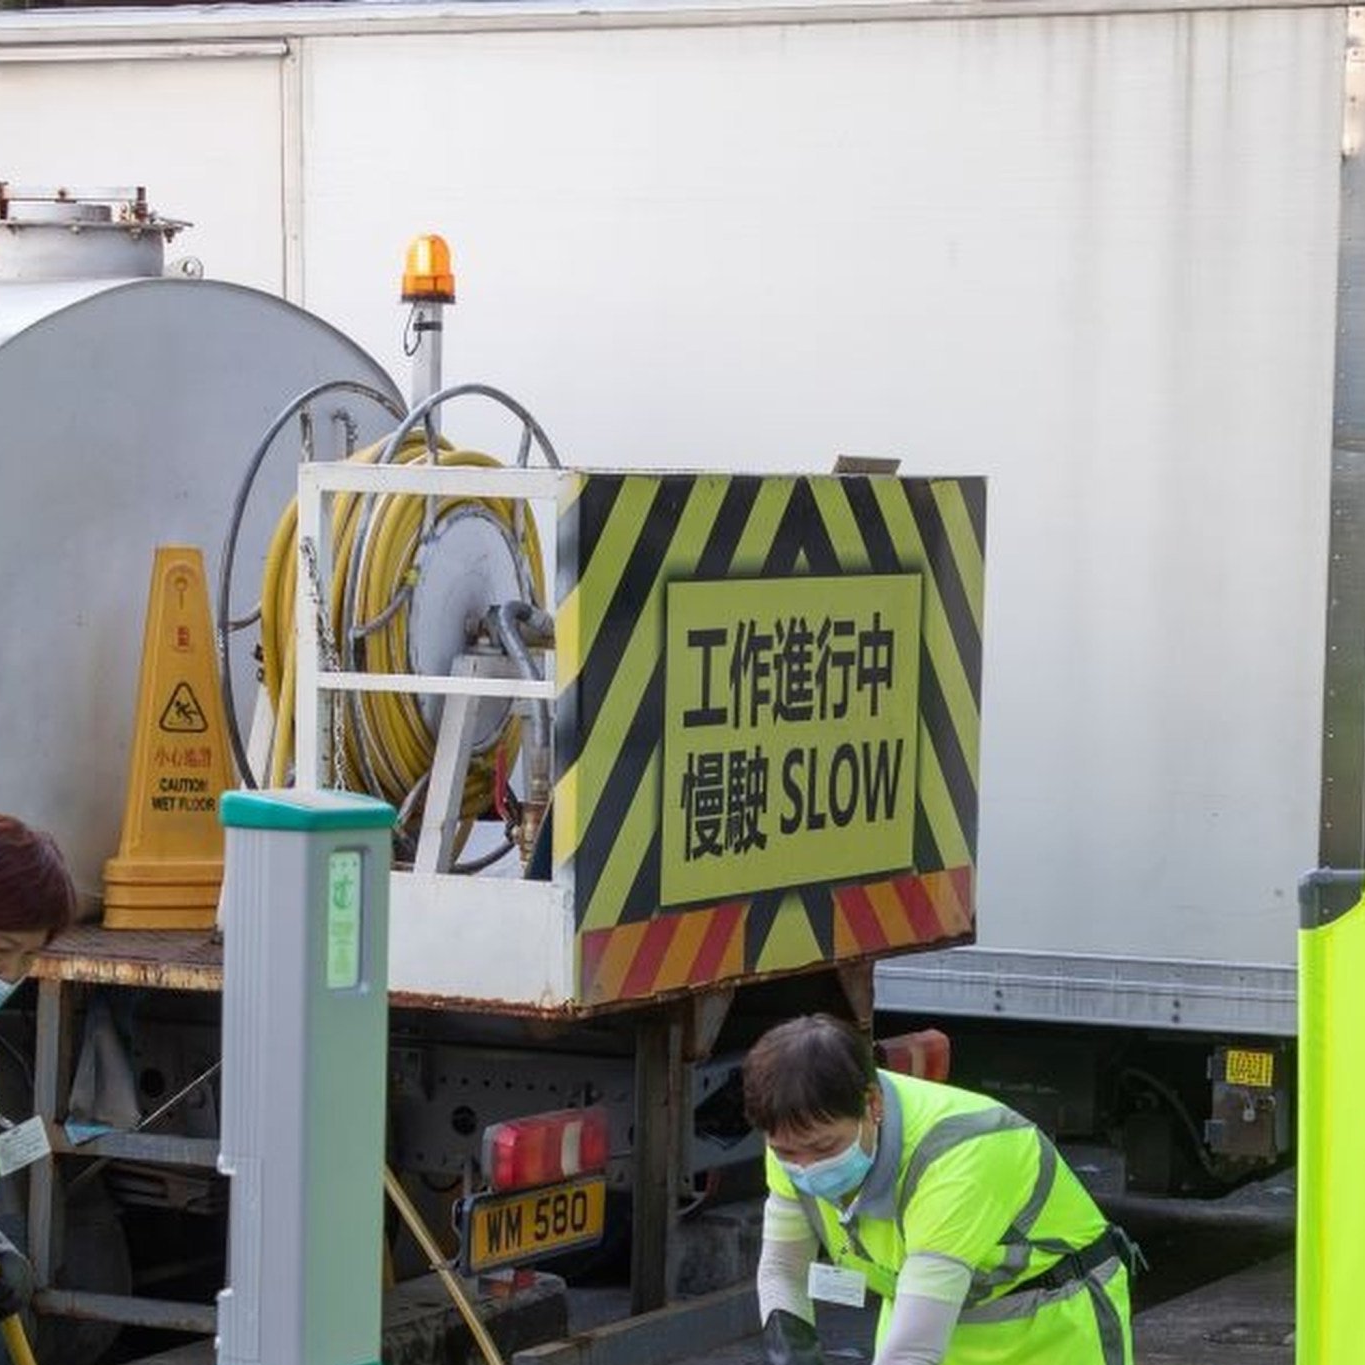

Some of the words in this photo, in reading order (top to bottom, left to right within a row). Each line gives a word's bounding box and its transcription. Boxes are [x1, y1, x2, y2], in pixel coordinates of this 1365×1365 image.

[682, 611, 895, 729] 工作進行中
[680, 746, 769, 862] 慢駛
[779, 738, 903, 835] SLOW
[486, 1203, 523, 1255] WM
[533, 1189, 588, 1242] 580
